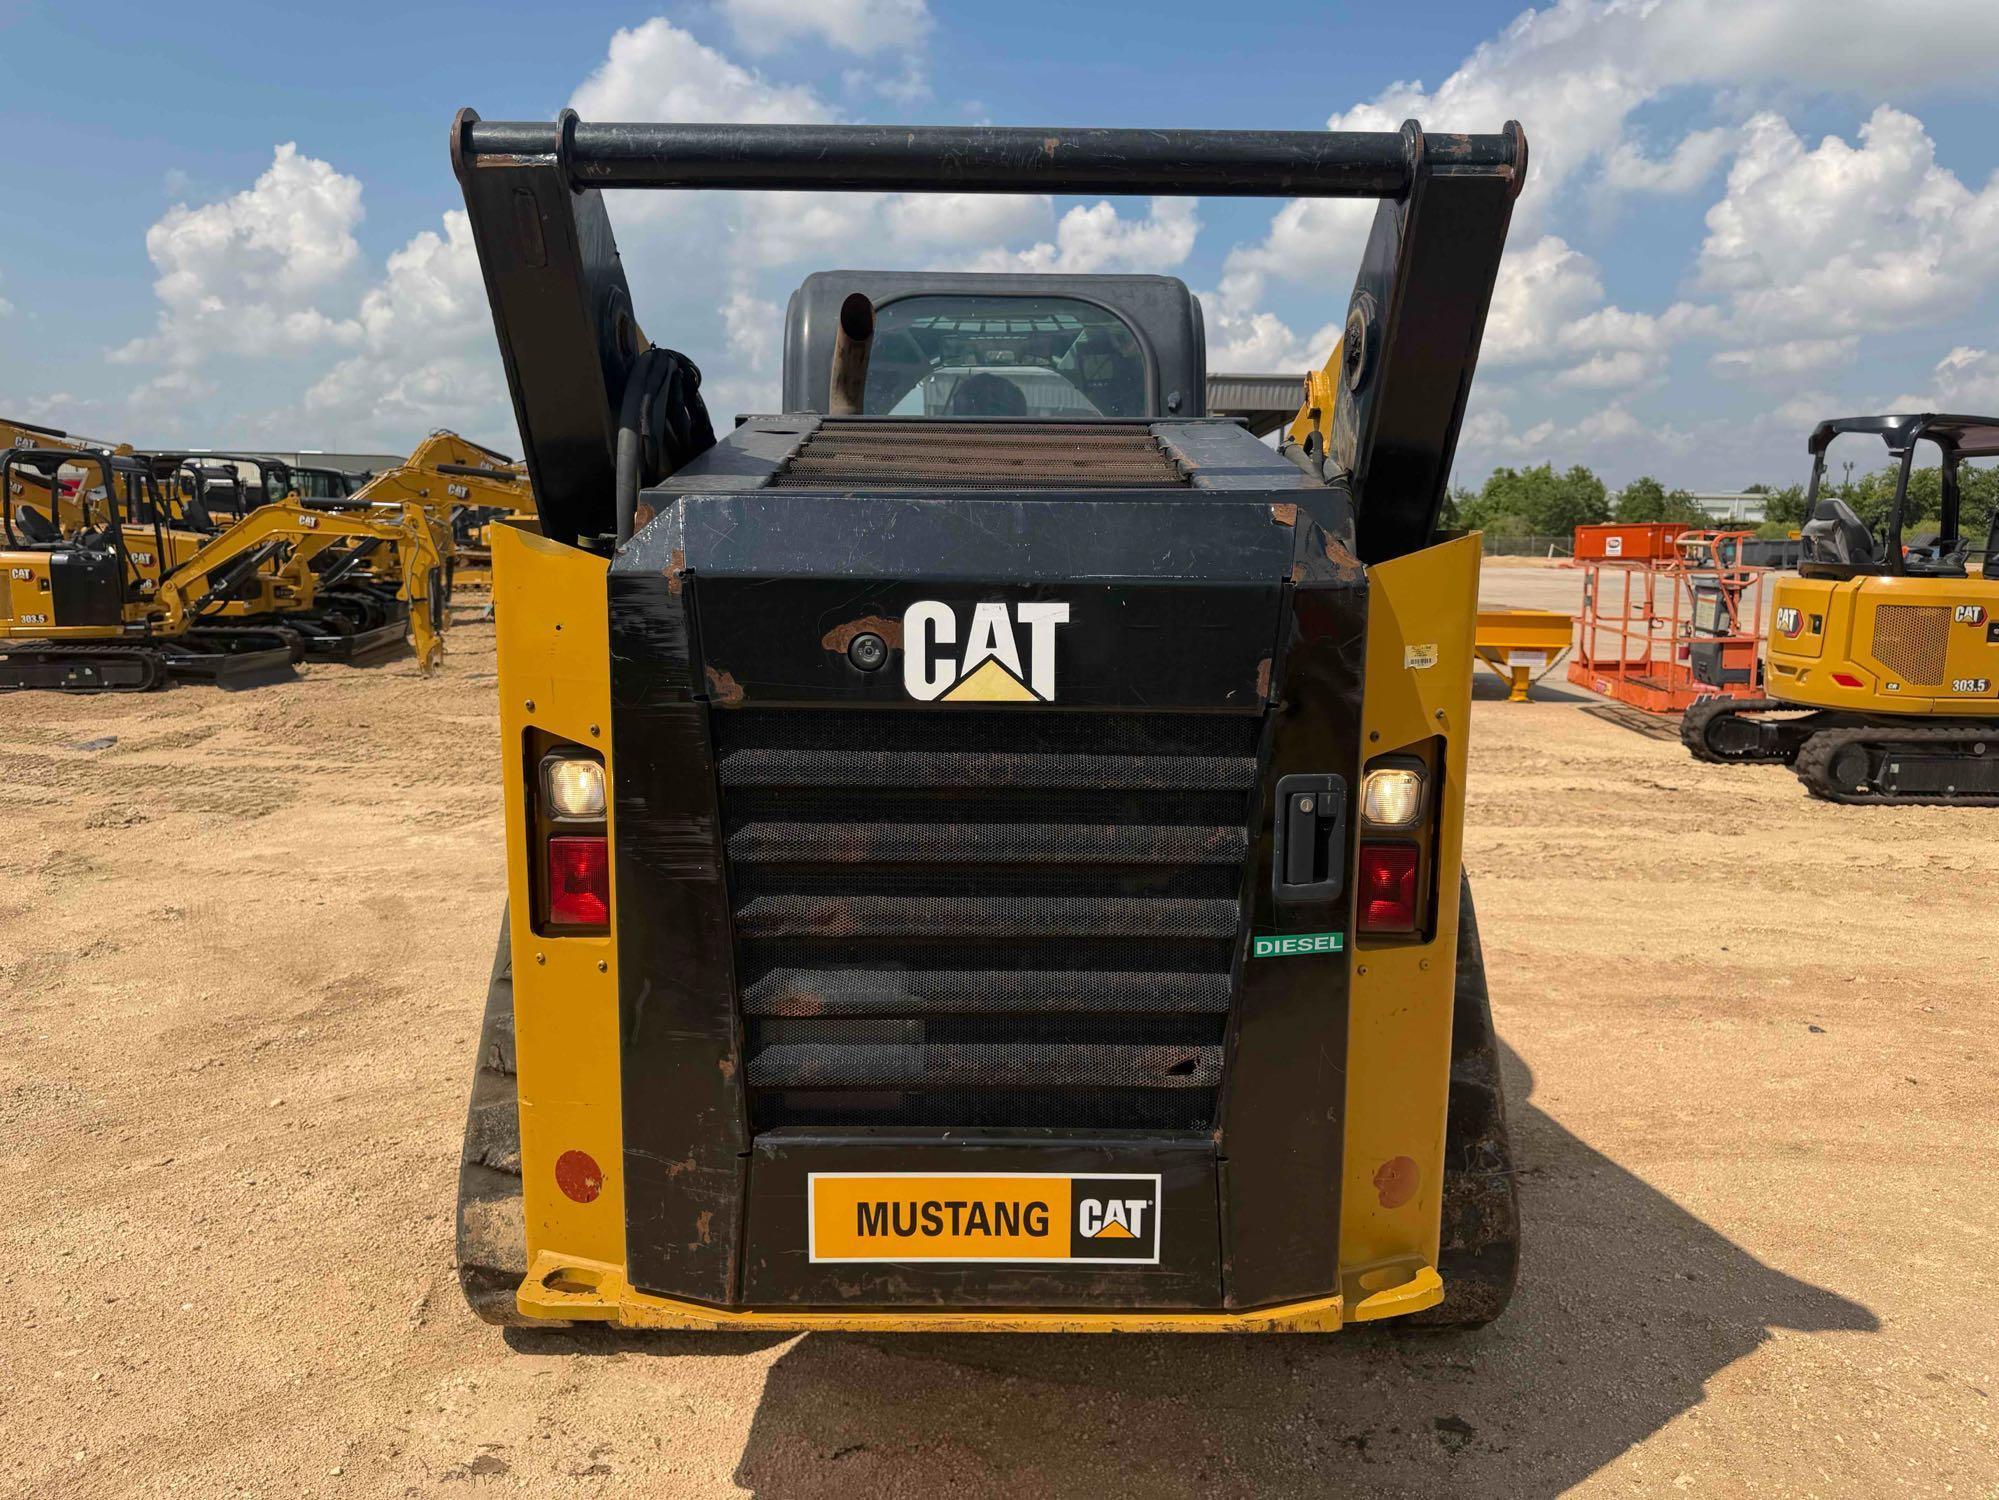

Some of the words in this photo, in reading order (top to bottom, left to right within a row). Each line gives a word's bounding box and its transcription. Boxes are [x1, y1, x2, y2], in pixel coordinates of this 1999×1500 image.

[15, 436, 35, 449] CAT
[447, 483, 468, 498] CAT
[299, 514, 317, 527] CAT
[131, 552, 152, 565] CAT
[12, 568, 30, 580] CAT
[20, 614, 45, 624] 303.5
[1776, 607, 1797, 632] CAT
[1954, 605, 1982, 623] CAT
[904, 601, 1069, 701] CAT
[1887, 683, 1898, 691] CR
[1952, 679, 1986, 692] 303.5
[1256, 935, 1343, 955] DIESEL
[856, 1200, 1050, 1237] MUSTANG
[1079, 1198, 1147, 1239] CAT
